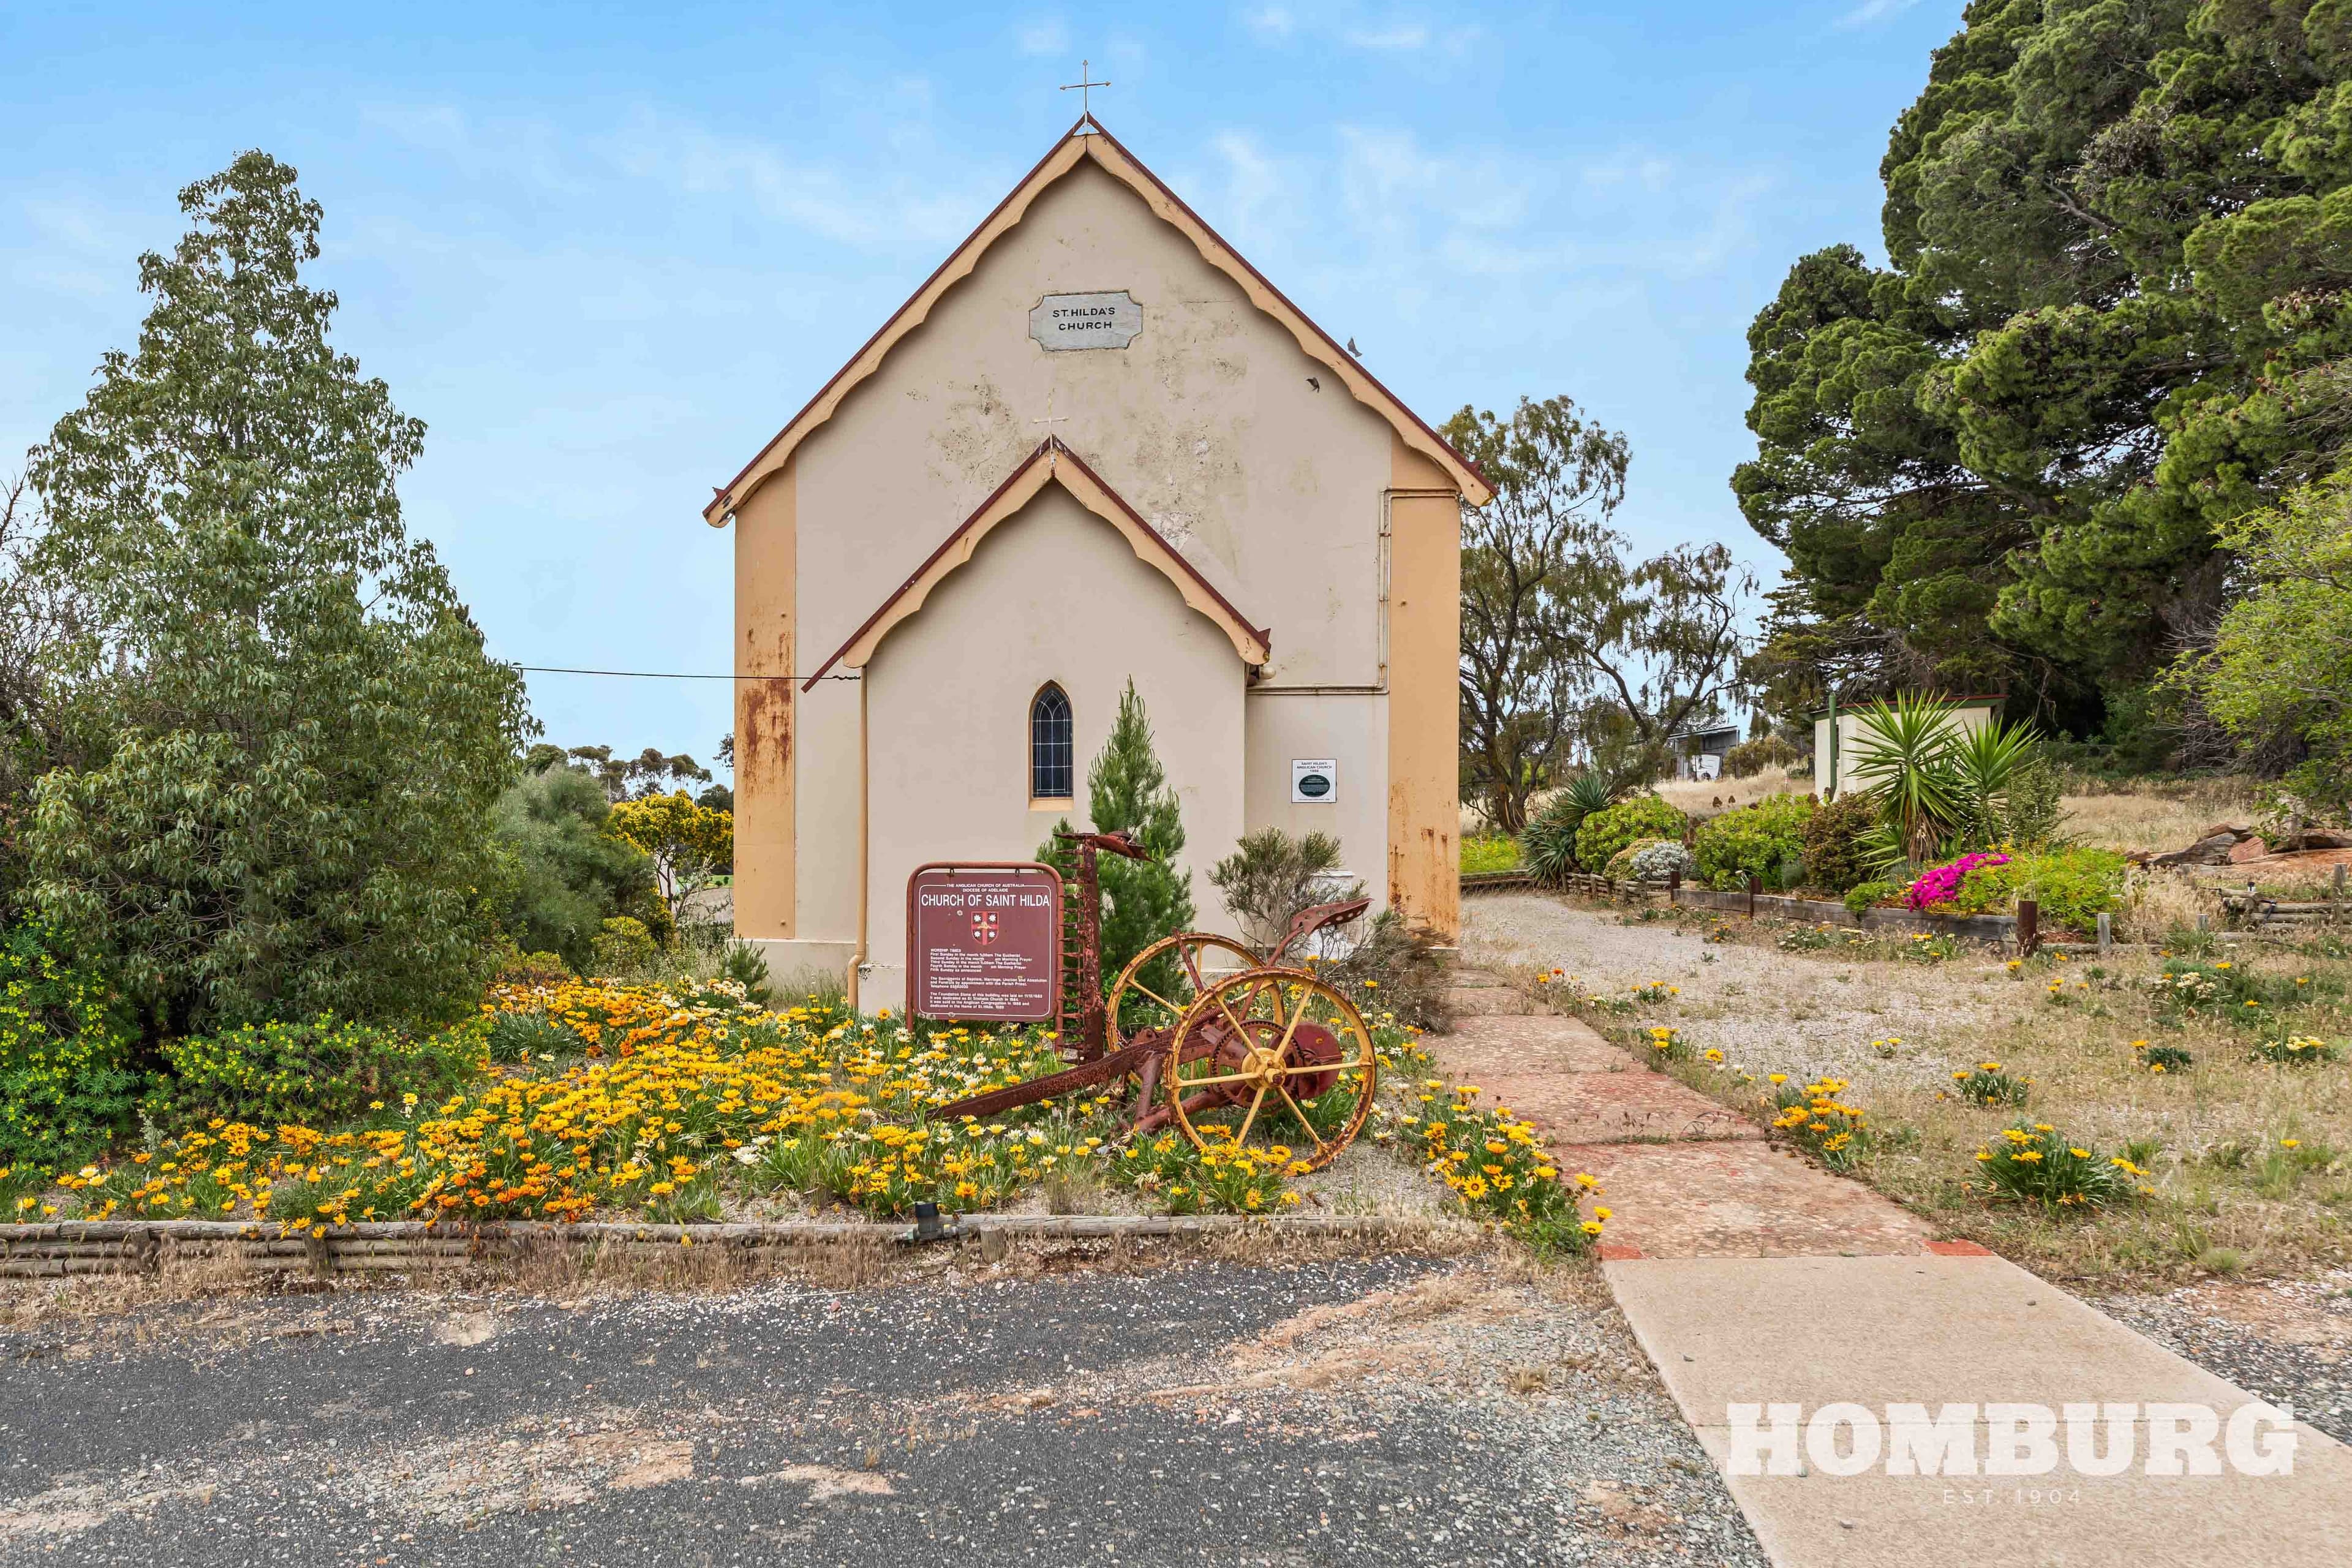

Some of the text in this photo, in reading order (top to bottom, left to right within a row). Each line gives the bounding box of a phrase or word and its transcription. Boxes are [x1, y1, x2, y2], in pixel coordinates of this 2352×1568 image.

[1058, 322, 1112, 331] CHURCH
[921, 894, 1050, 907] CHURCH OF SAINT HILDA
